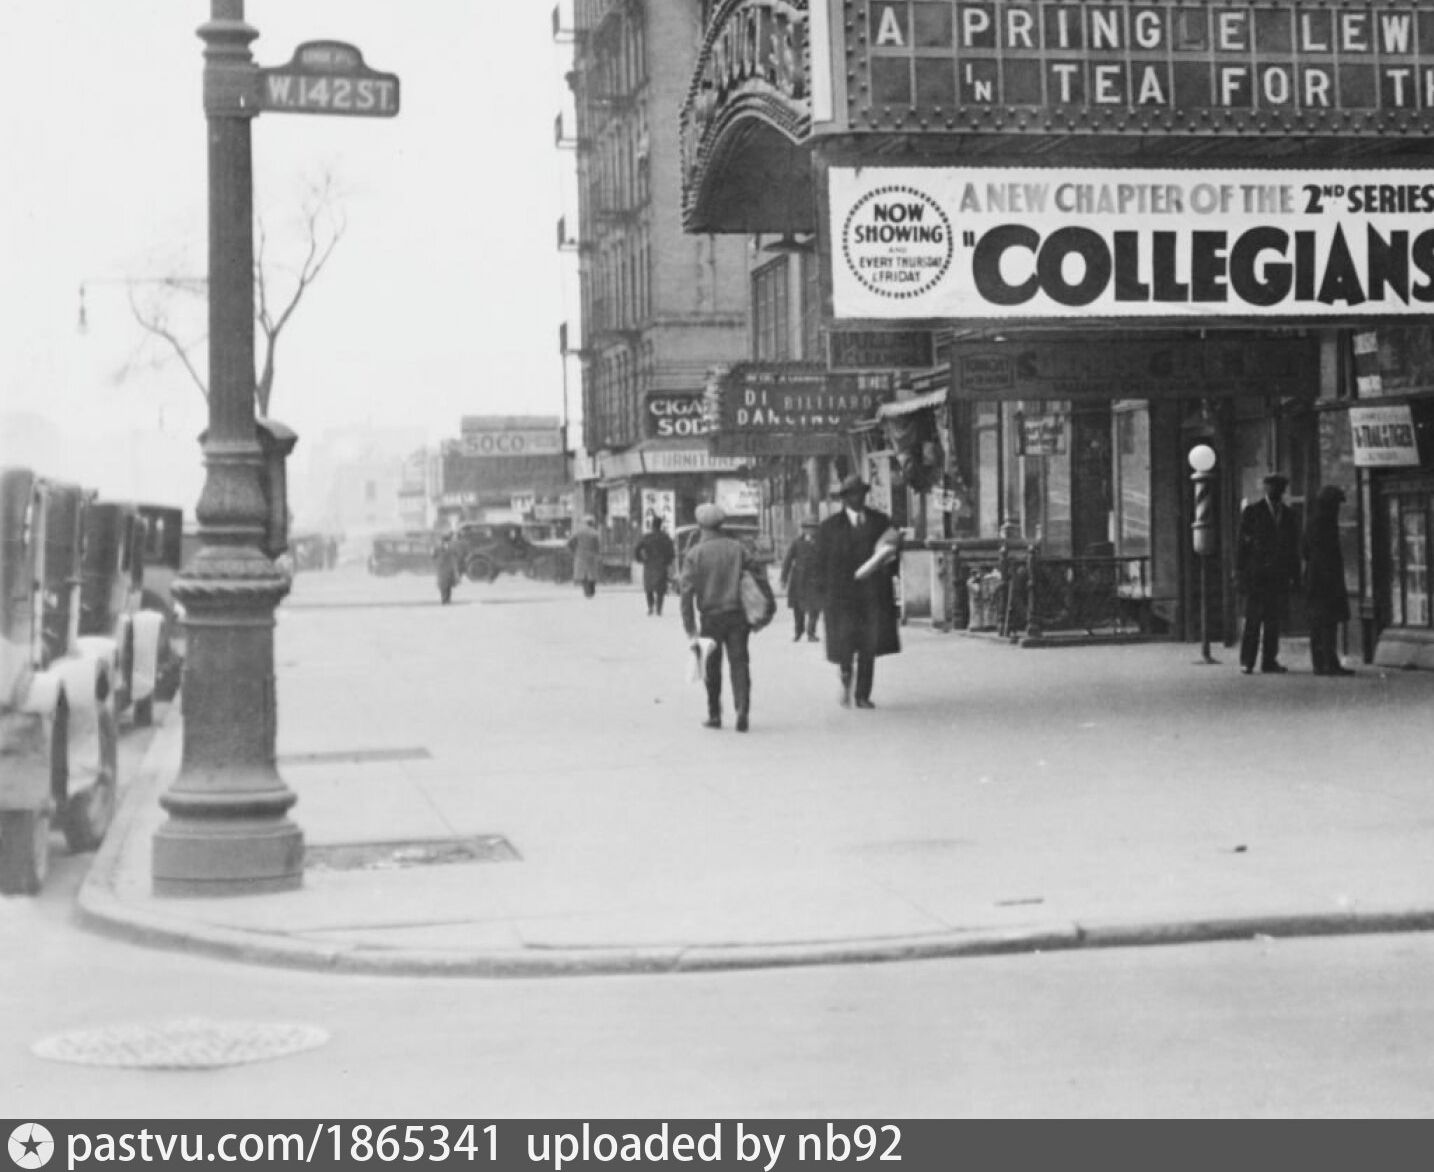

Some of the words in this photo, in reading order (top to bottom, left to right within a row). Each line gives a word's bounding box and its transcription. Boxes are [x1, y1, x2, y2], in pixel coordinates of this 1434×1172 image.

[876, 6, 904, 46] A
[963, 7, 1246, 51] PRINGLE
[1301, 13, 1410, 53] LEW
[1052, 64, 1166, 105] TEA
[1221, 66, 1331, 108] FOR
[959, 182, 982, 214] A
[986, 182, 1050, 214] NEW
[1054, 182, 1184, 215] CHAPTER
[1190, 182, 1235, 215] OF
[1240, 183, 1295, 214] THE
[1303, 183, 1345, 214] 2ND
[874, 203, 925, 223] NOW
[854, 224, 943, 244] SHOWING
[859, 256, 893, 269] EVERY
[649, 398, 704, 416] CIGA
